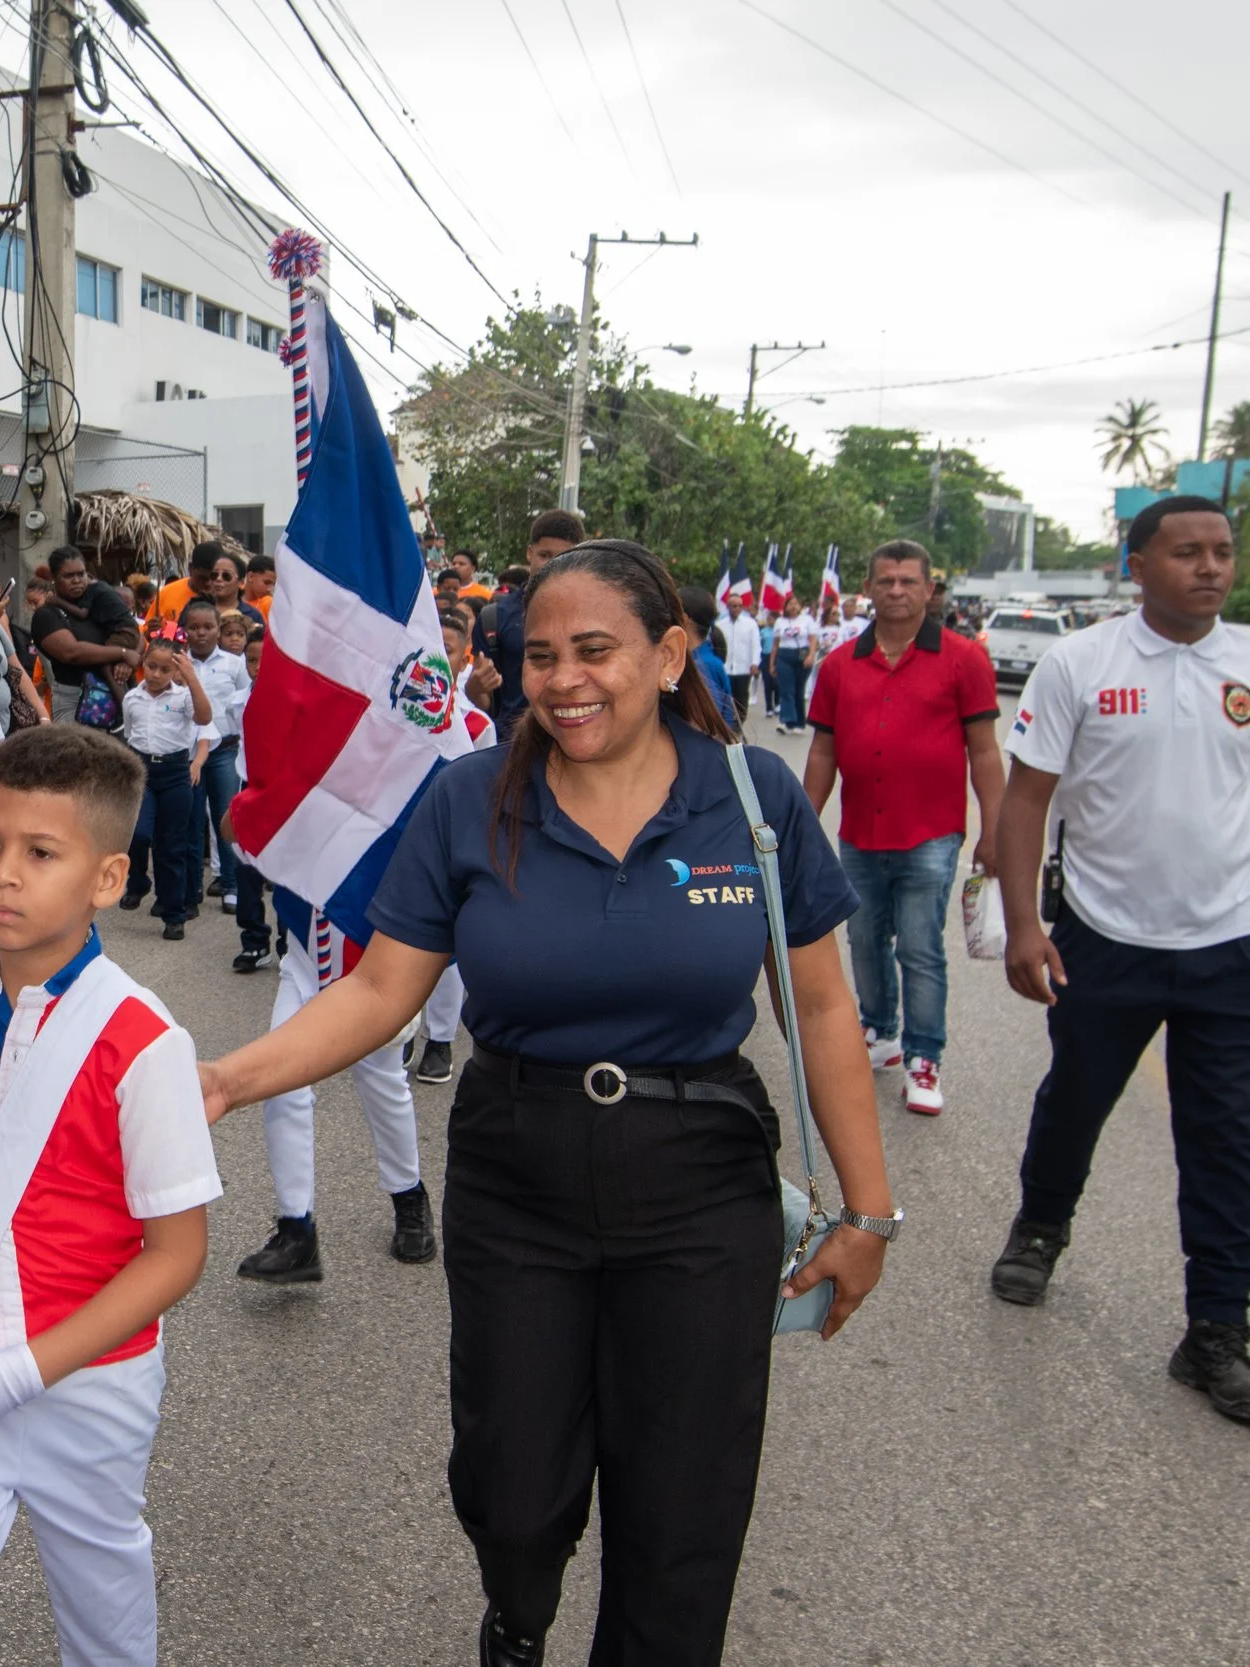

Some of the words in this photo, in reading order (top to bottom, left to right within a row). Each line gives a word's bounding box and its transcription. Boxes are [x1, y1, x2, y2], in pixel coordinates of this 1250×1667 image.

[1098, 687, 1139, 715] 911
[691, 864, 733, 876] DREAM
[733, 862, 760, 876] projec
[687, 886, 755, 905] STAFF
